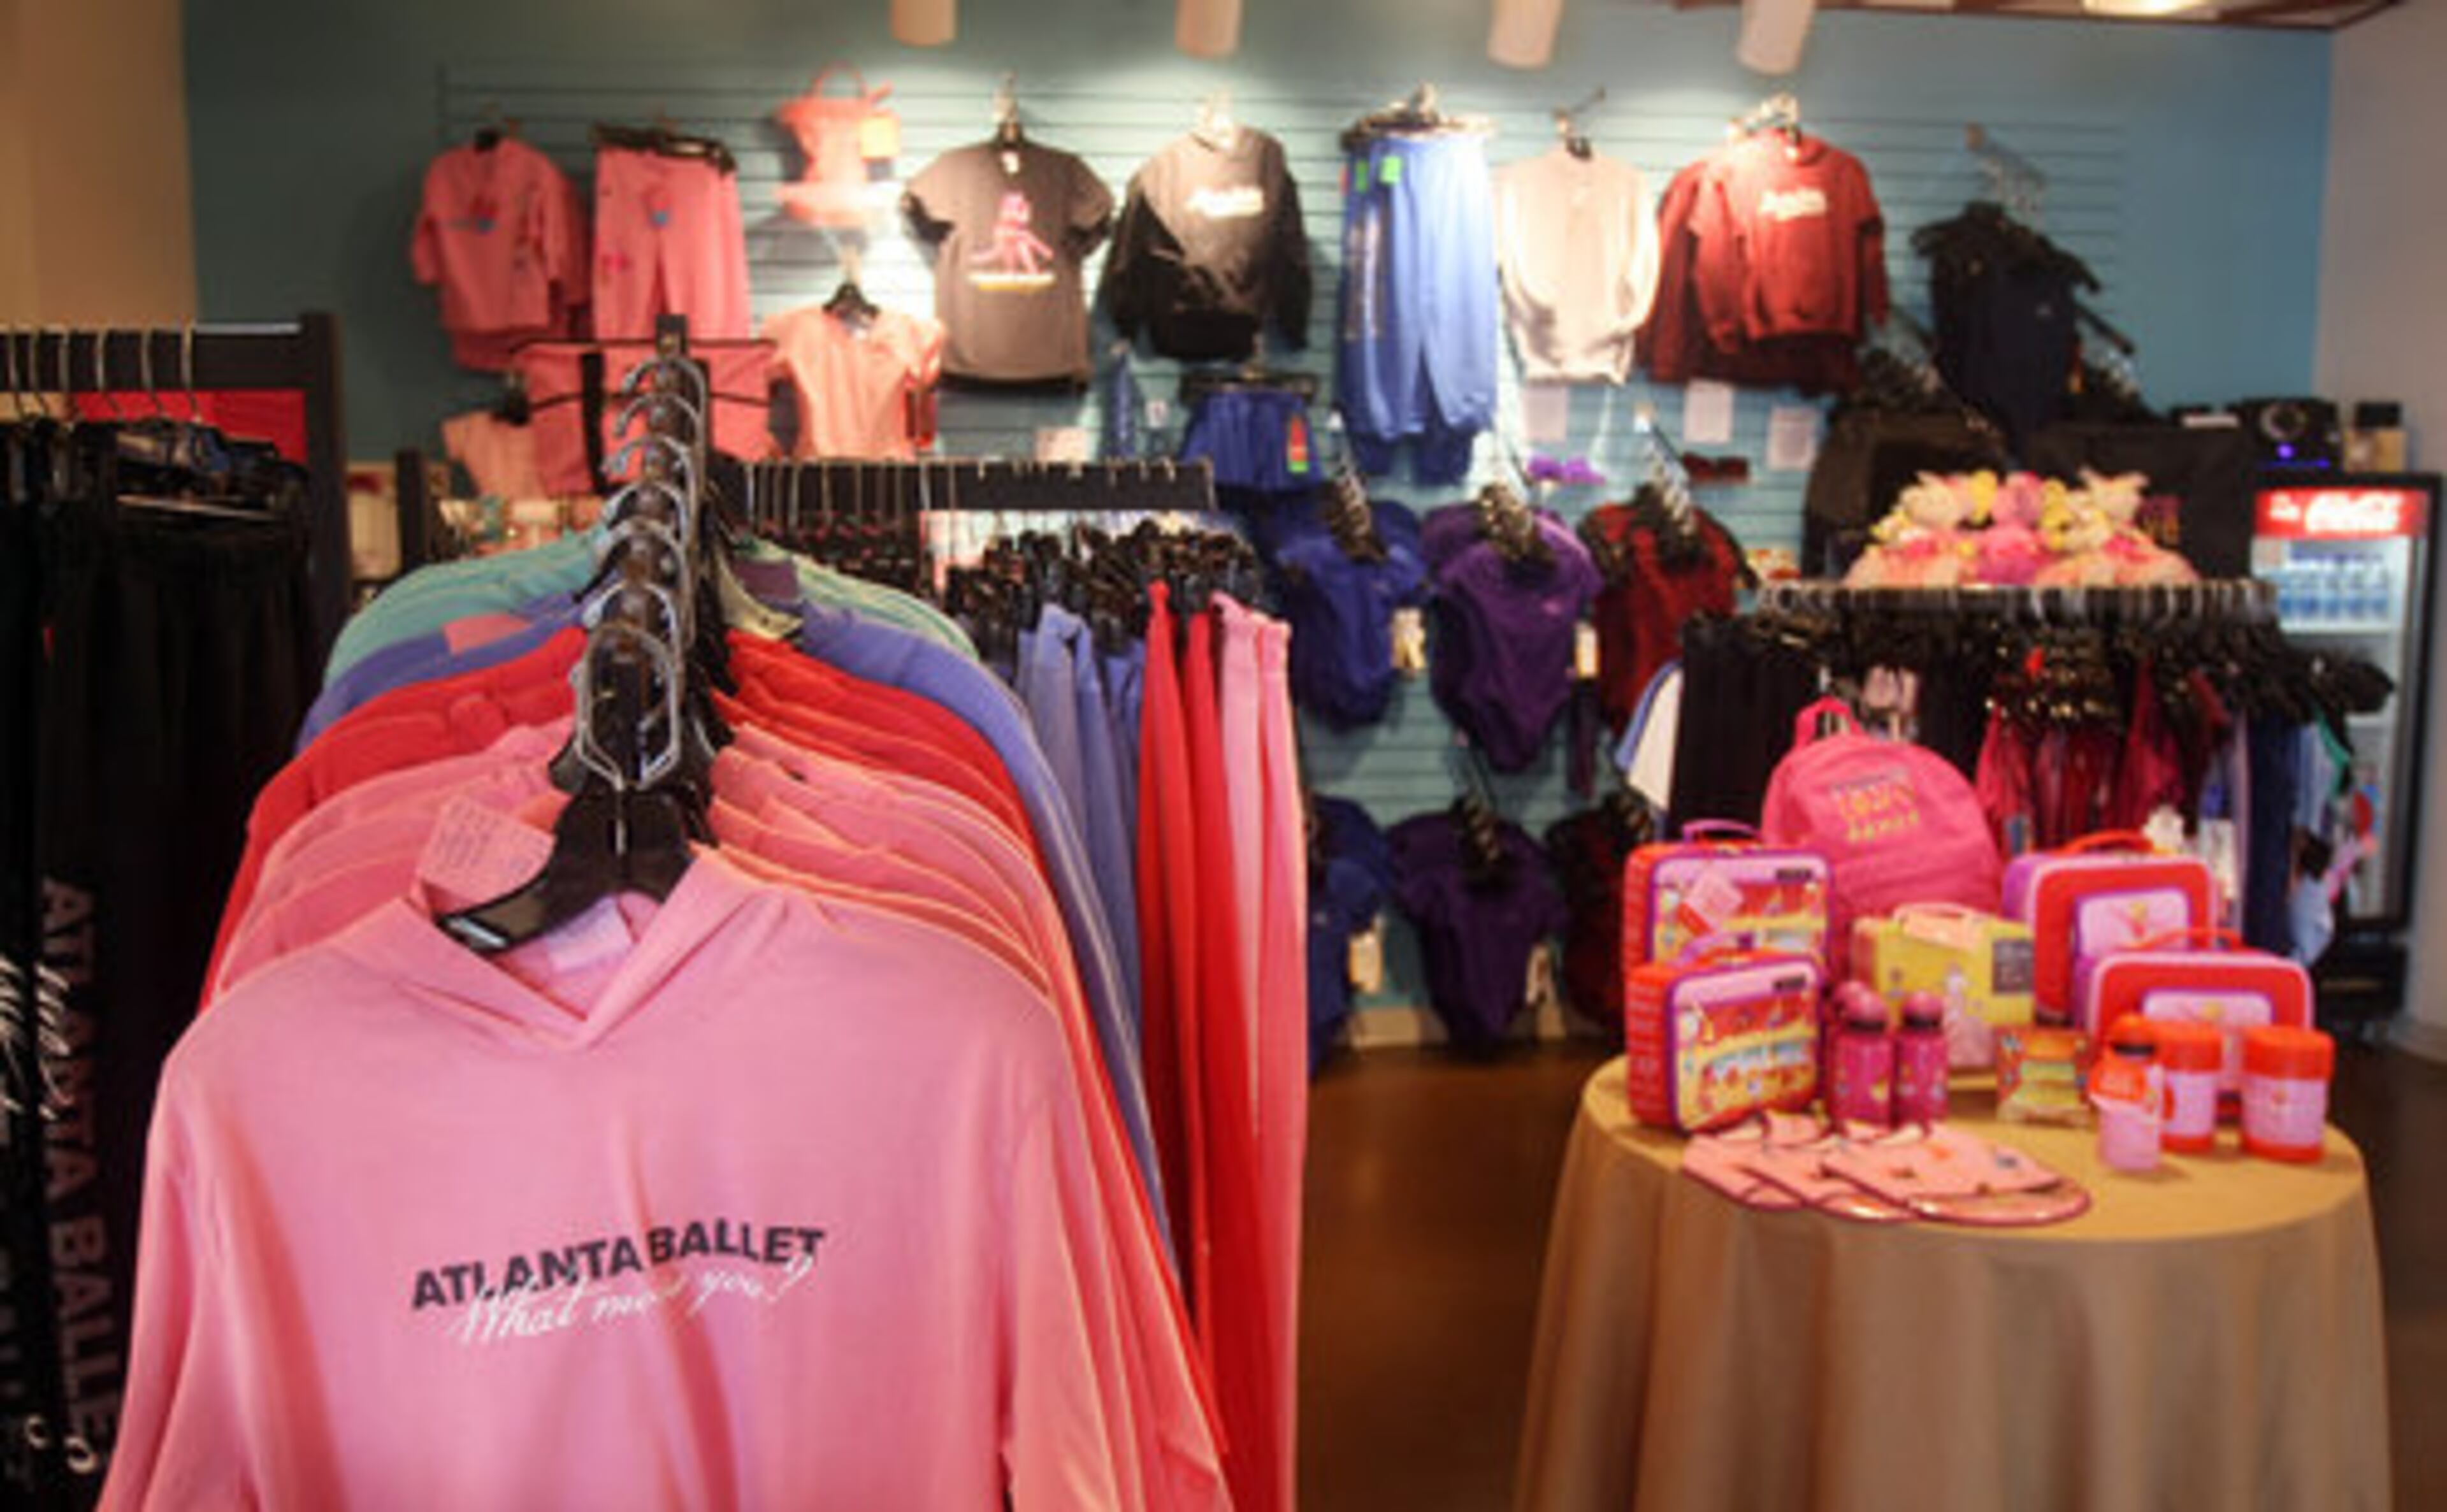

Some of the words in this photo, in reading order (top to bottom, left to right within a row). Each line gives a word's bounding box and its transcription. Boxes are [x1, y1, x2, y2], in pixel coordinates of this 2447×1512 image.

[48, 1216, 121, 1440] BALLE
[411, 1235, 643, 1310] ATLANTA
[646, 1217, 825, 1267] BALLET
